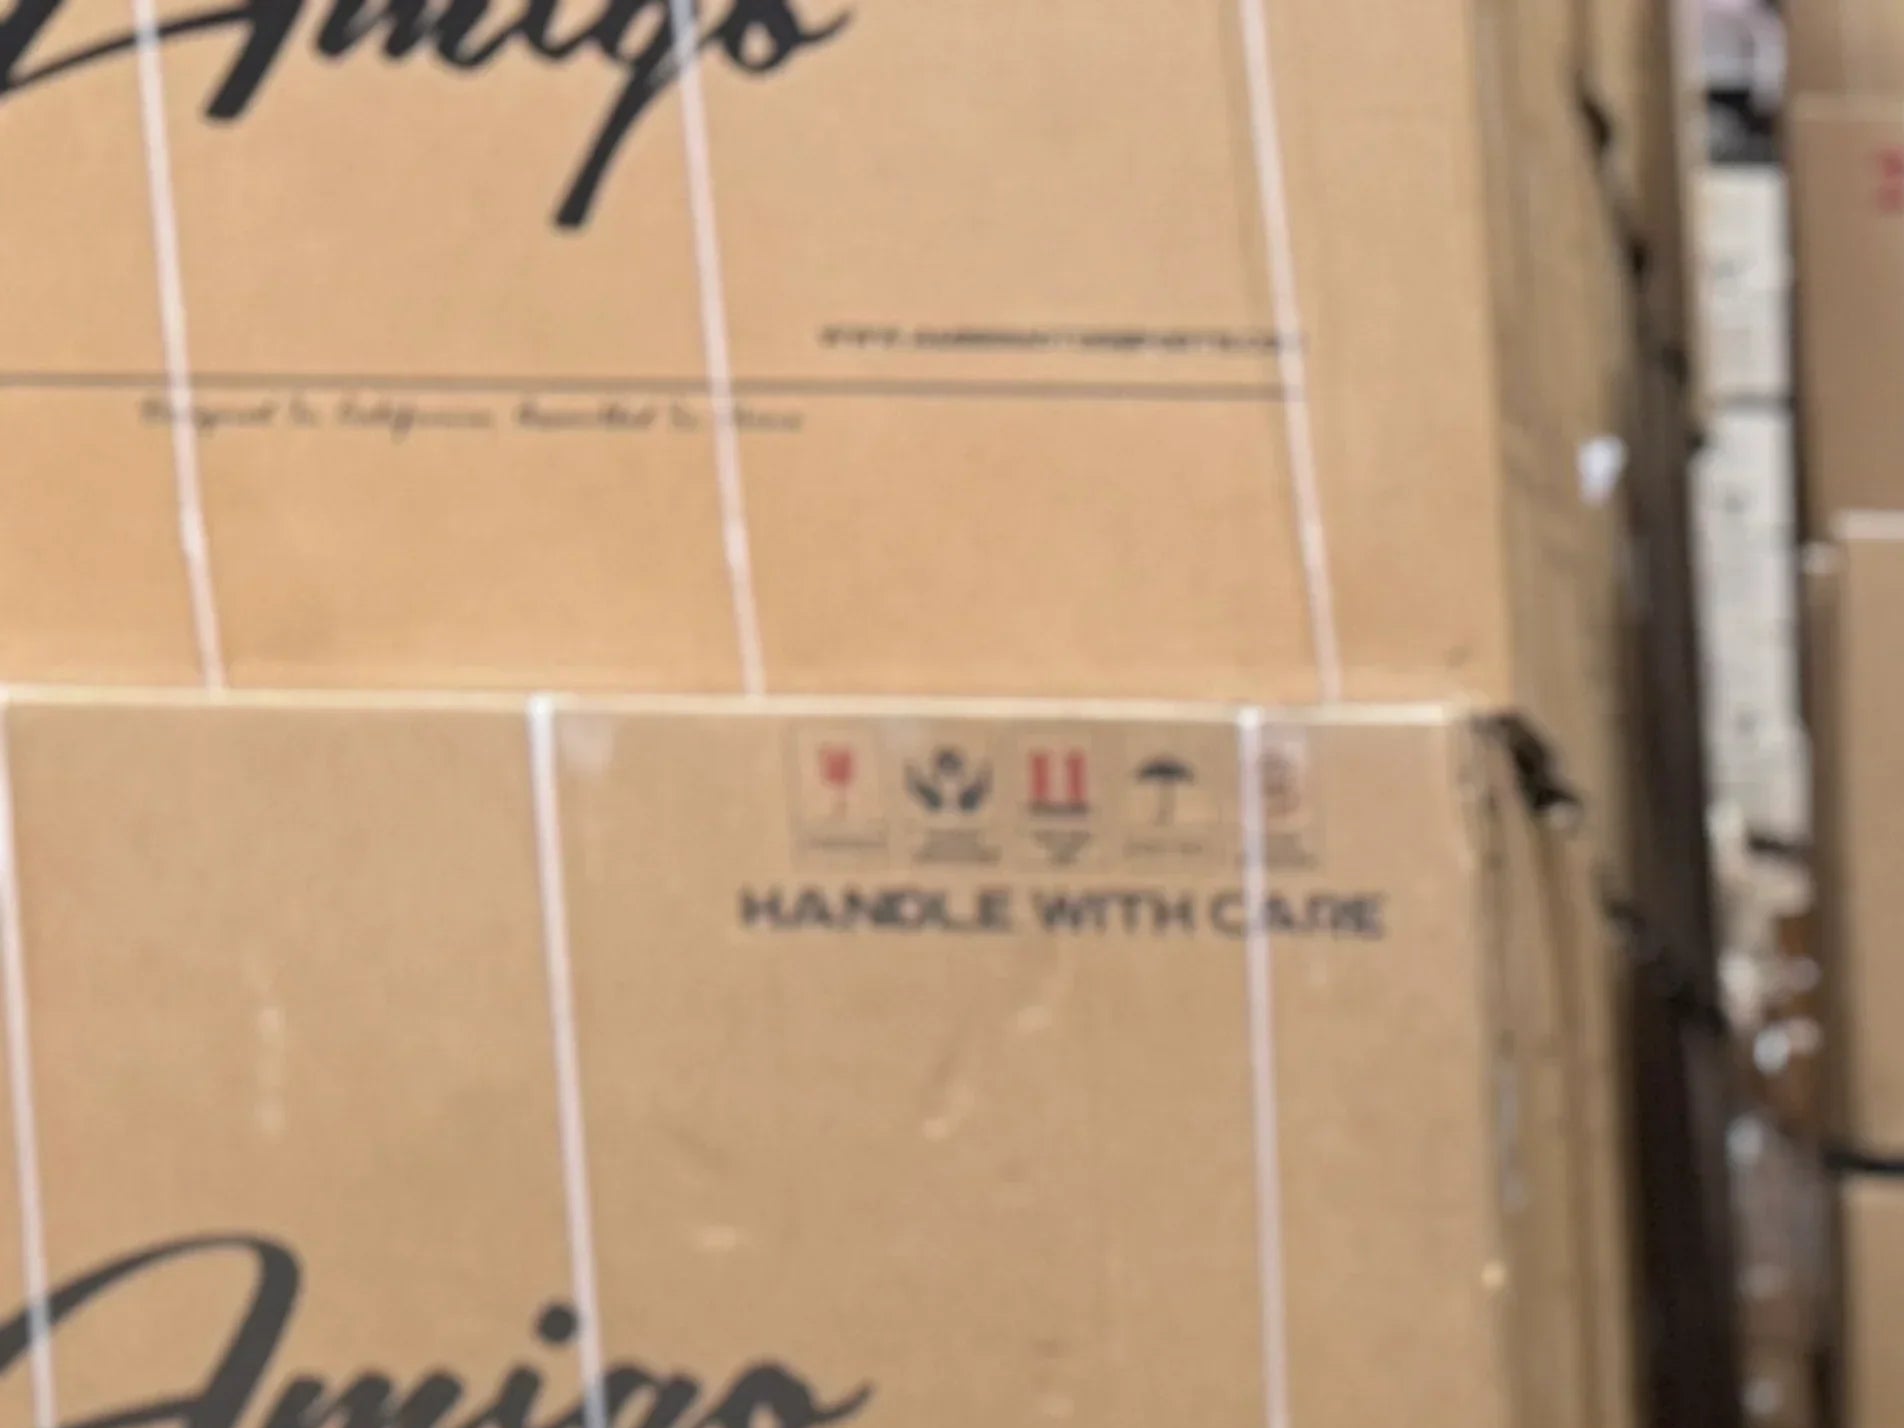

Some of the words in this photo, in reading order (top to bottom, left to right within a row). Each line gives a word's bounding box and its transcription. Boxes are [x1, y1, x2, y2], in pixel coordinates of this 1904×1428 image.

[737, 885, 1013, 935] HANDLE
[1031, 887, 1194, 936] WITH
[1209, 889, 1387, 940] CARE
